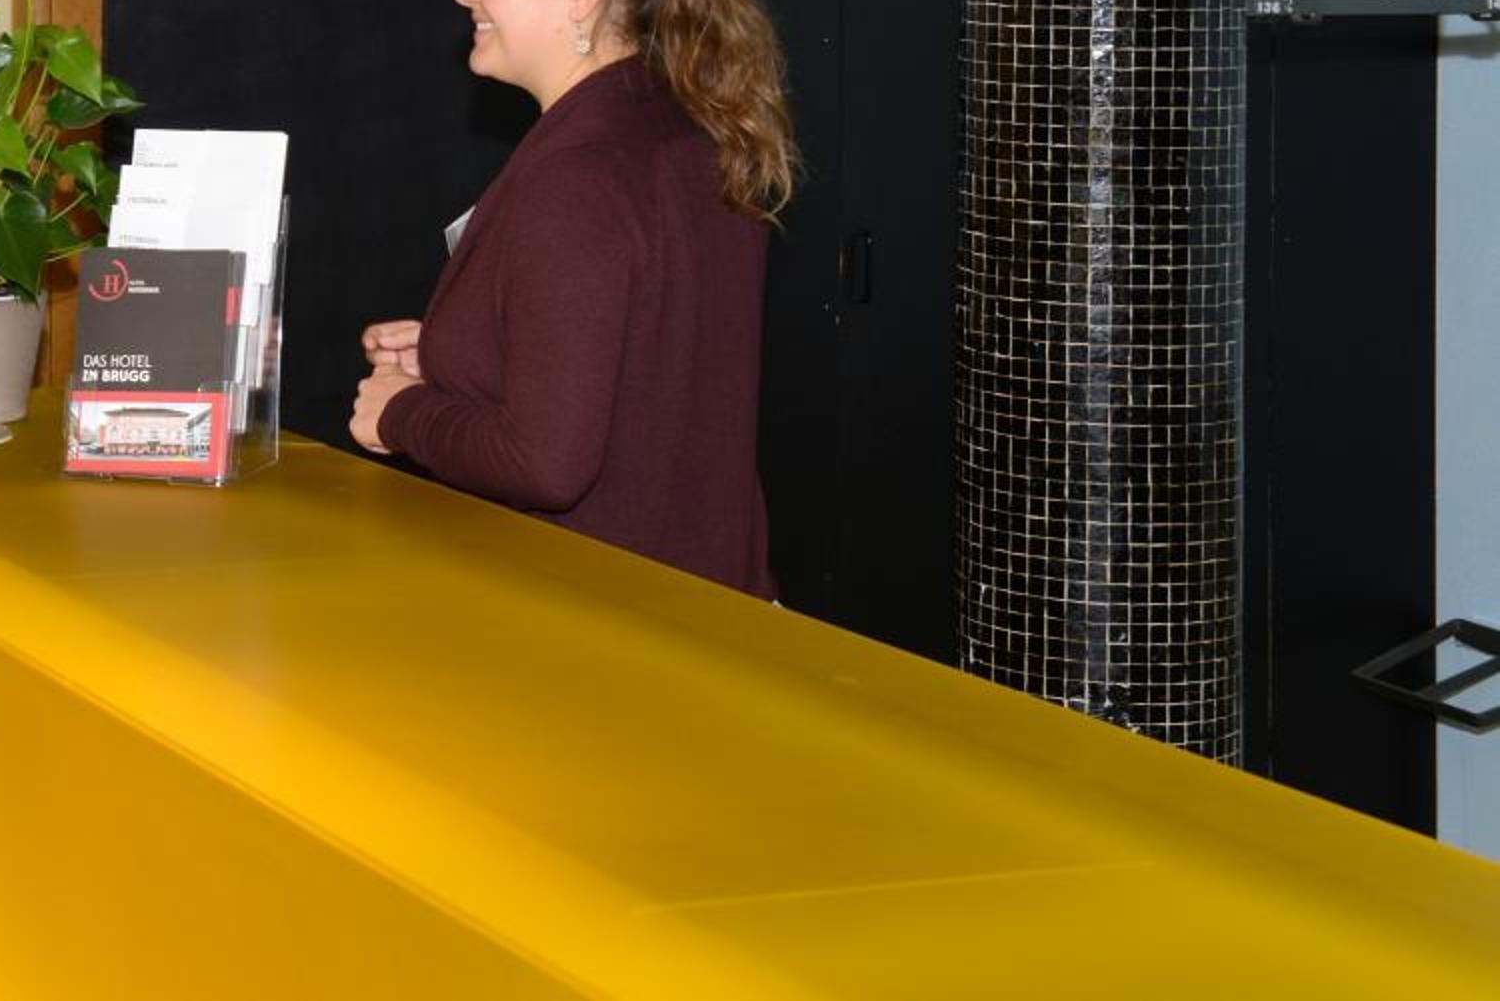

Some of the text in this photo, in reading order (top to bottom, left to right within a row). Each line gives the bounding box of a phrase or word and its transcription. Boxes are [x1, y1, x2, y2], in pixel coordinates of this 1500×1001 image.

[83, 354, 152, 368] DAS HOTEL
[102, 370, 150, 382] BRUGG
